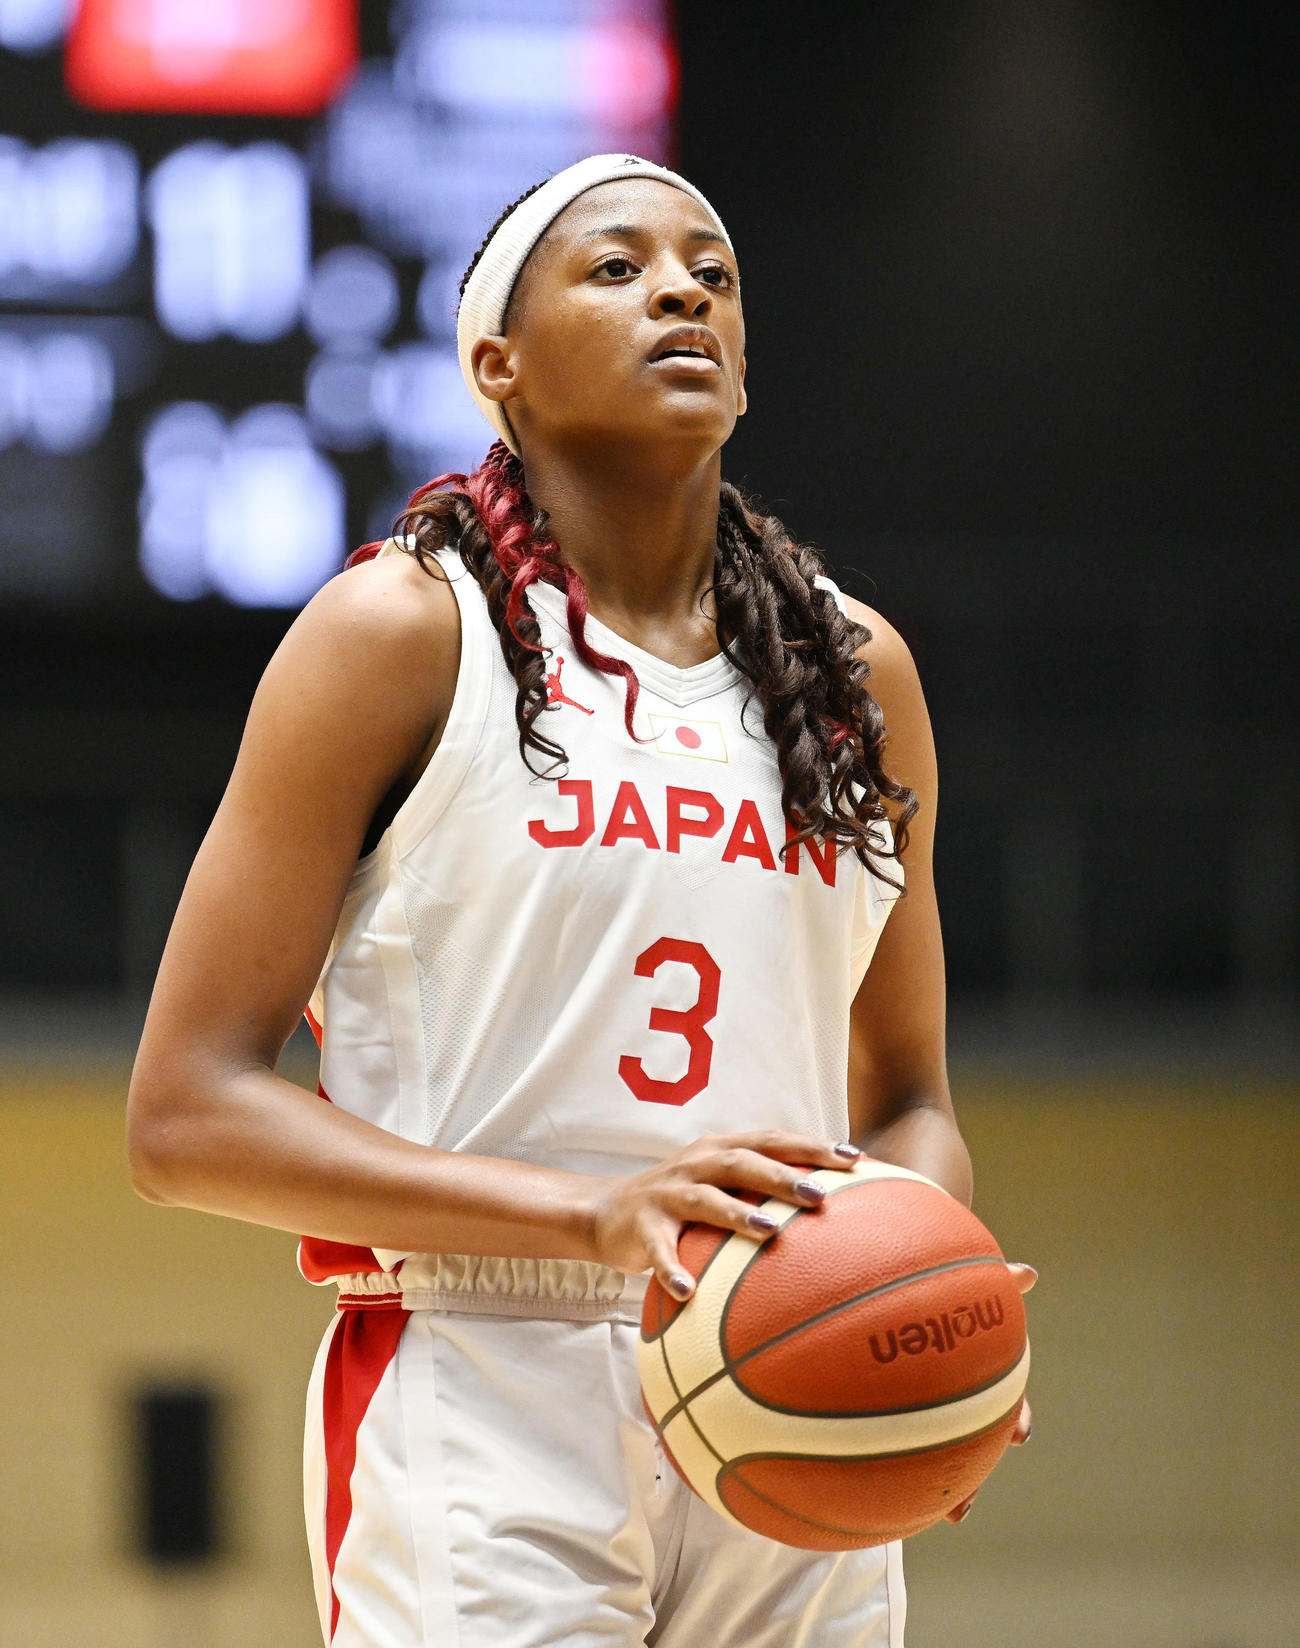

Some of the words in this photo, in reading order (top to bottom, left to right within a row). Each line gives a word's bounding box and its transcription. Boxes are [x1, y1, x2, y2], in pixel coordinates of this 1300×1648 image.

[528, 779, 837, 888] JAPAN
[618, 937, 721, 1106] 3
[868, 1294, 1004, 1364] molten
